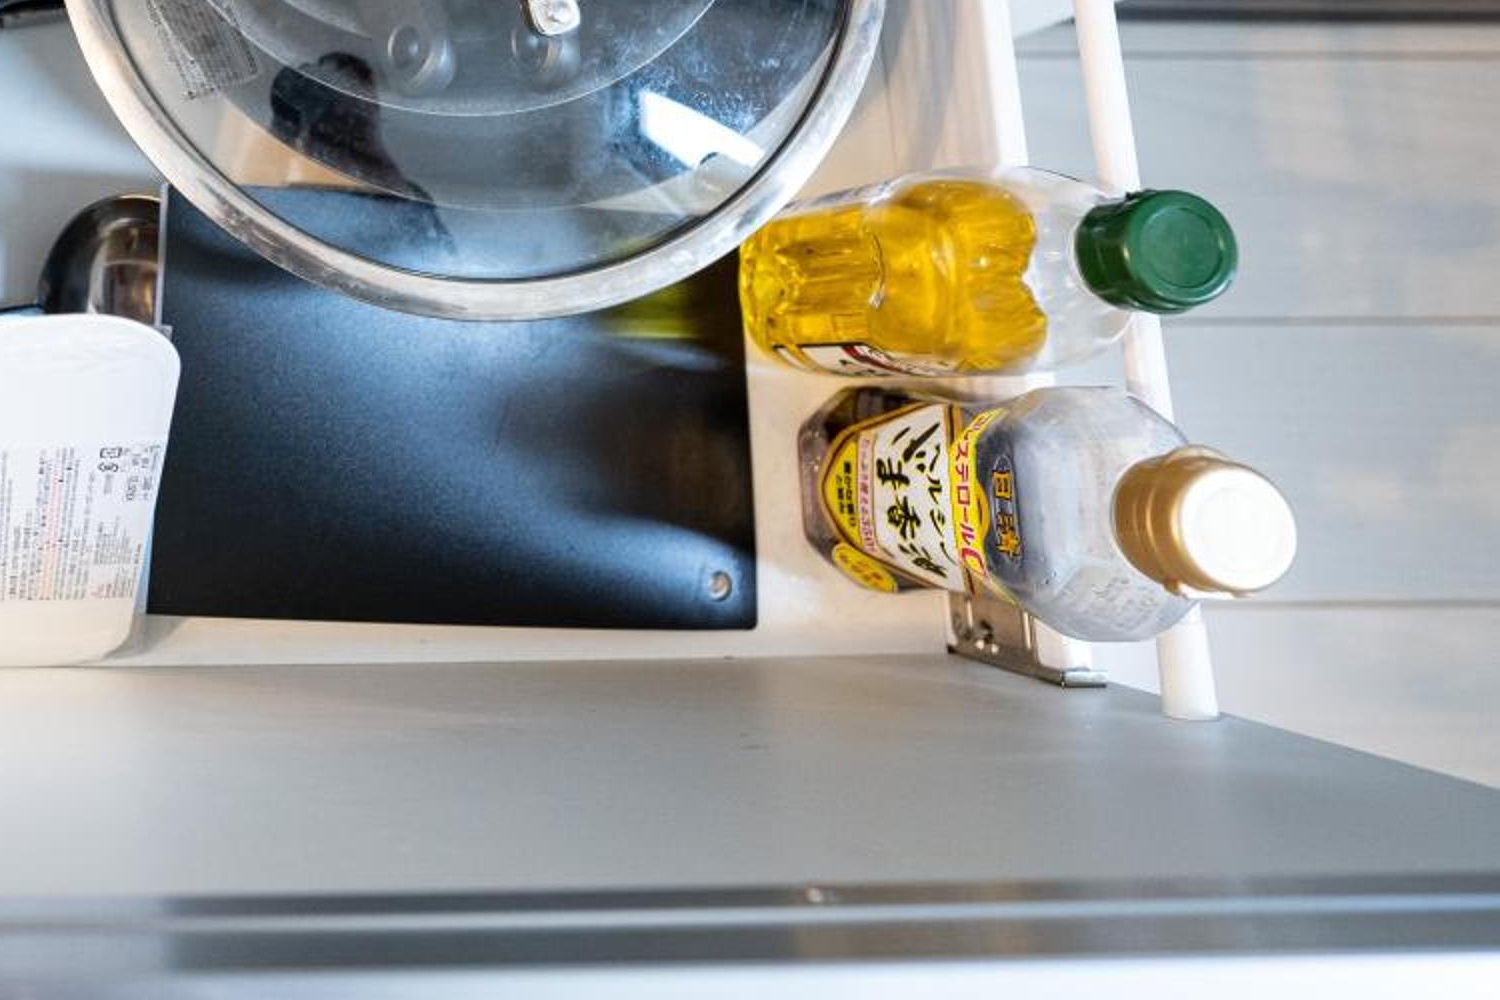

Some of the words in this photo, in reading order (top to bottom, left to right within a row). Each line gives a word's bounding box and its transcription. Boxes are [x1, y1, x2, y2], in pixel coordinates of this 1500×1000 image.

[876, 422, 947, 578] ごま香油
[927, 444, 958, 566] ヘルシー
[992, 470, 1021, 559] 日清
